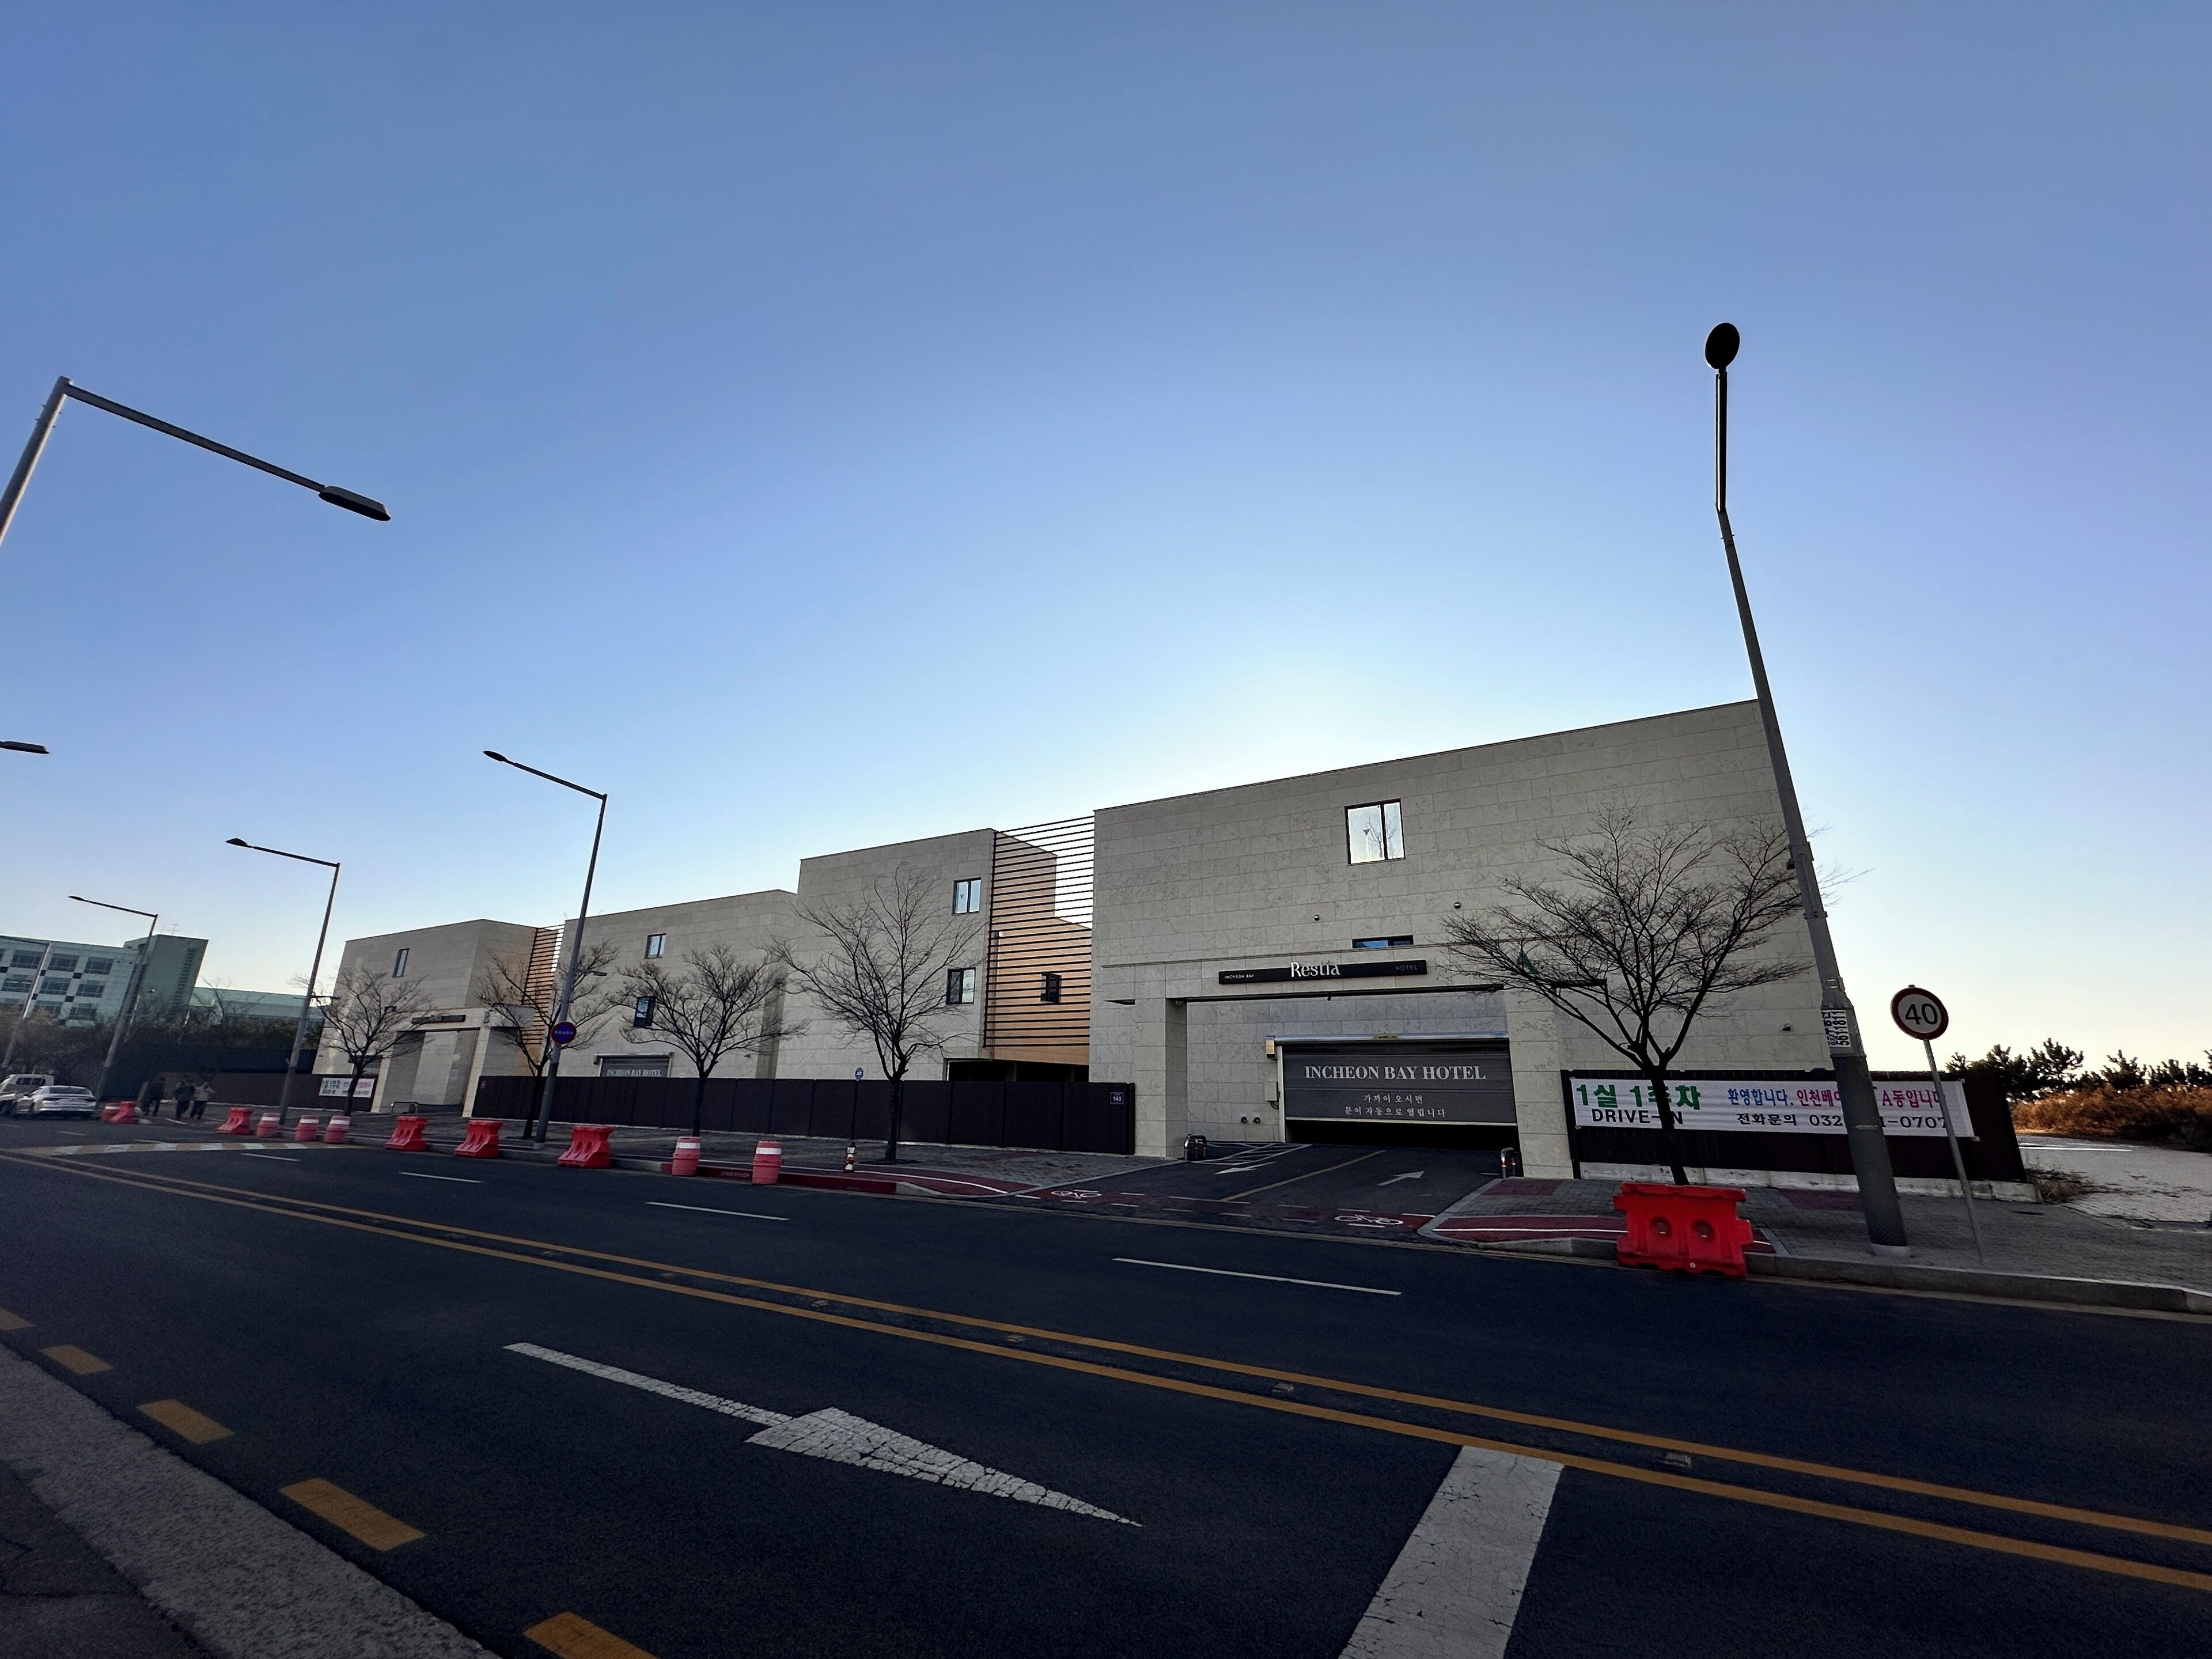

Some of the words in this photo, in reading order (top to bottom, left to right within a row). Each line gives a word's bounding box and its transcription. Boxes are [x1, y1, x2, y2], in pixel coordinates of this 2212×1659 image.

[1290, 960, 1341, 978] Restia
[1905, 1003, 1938, 1025] 40
[1304, 1066, 1380, 1079] INCHEON
[1384, 1066, 1418, 1080] BAY
[1422, 1066, 1486, 1080] HOTEL
[1363, 1094, 1391, 1103] 가까이
[1395, 1094, 1423, 1104] 오시면
[1576, 1084, 1618, 1108] 1실
[1728, 1088, 1793, 1107] 환영합니다.
[1344, 1106, 1362, 1115] 문이
[1365, 1107, 1403, 1116] 자동으로
[1406, 1107, 1446, 1118] 열립니다
[1592, 1108, 1684, 1124] DRIVE-N
[1737, 1113, 1797, 1126] 전화문의
